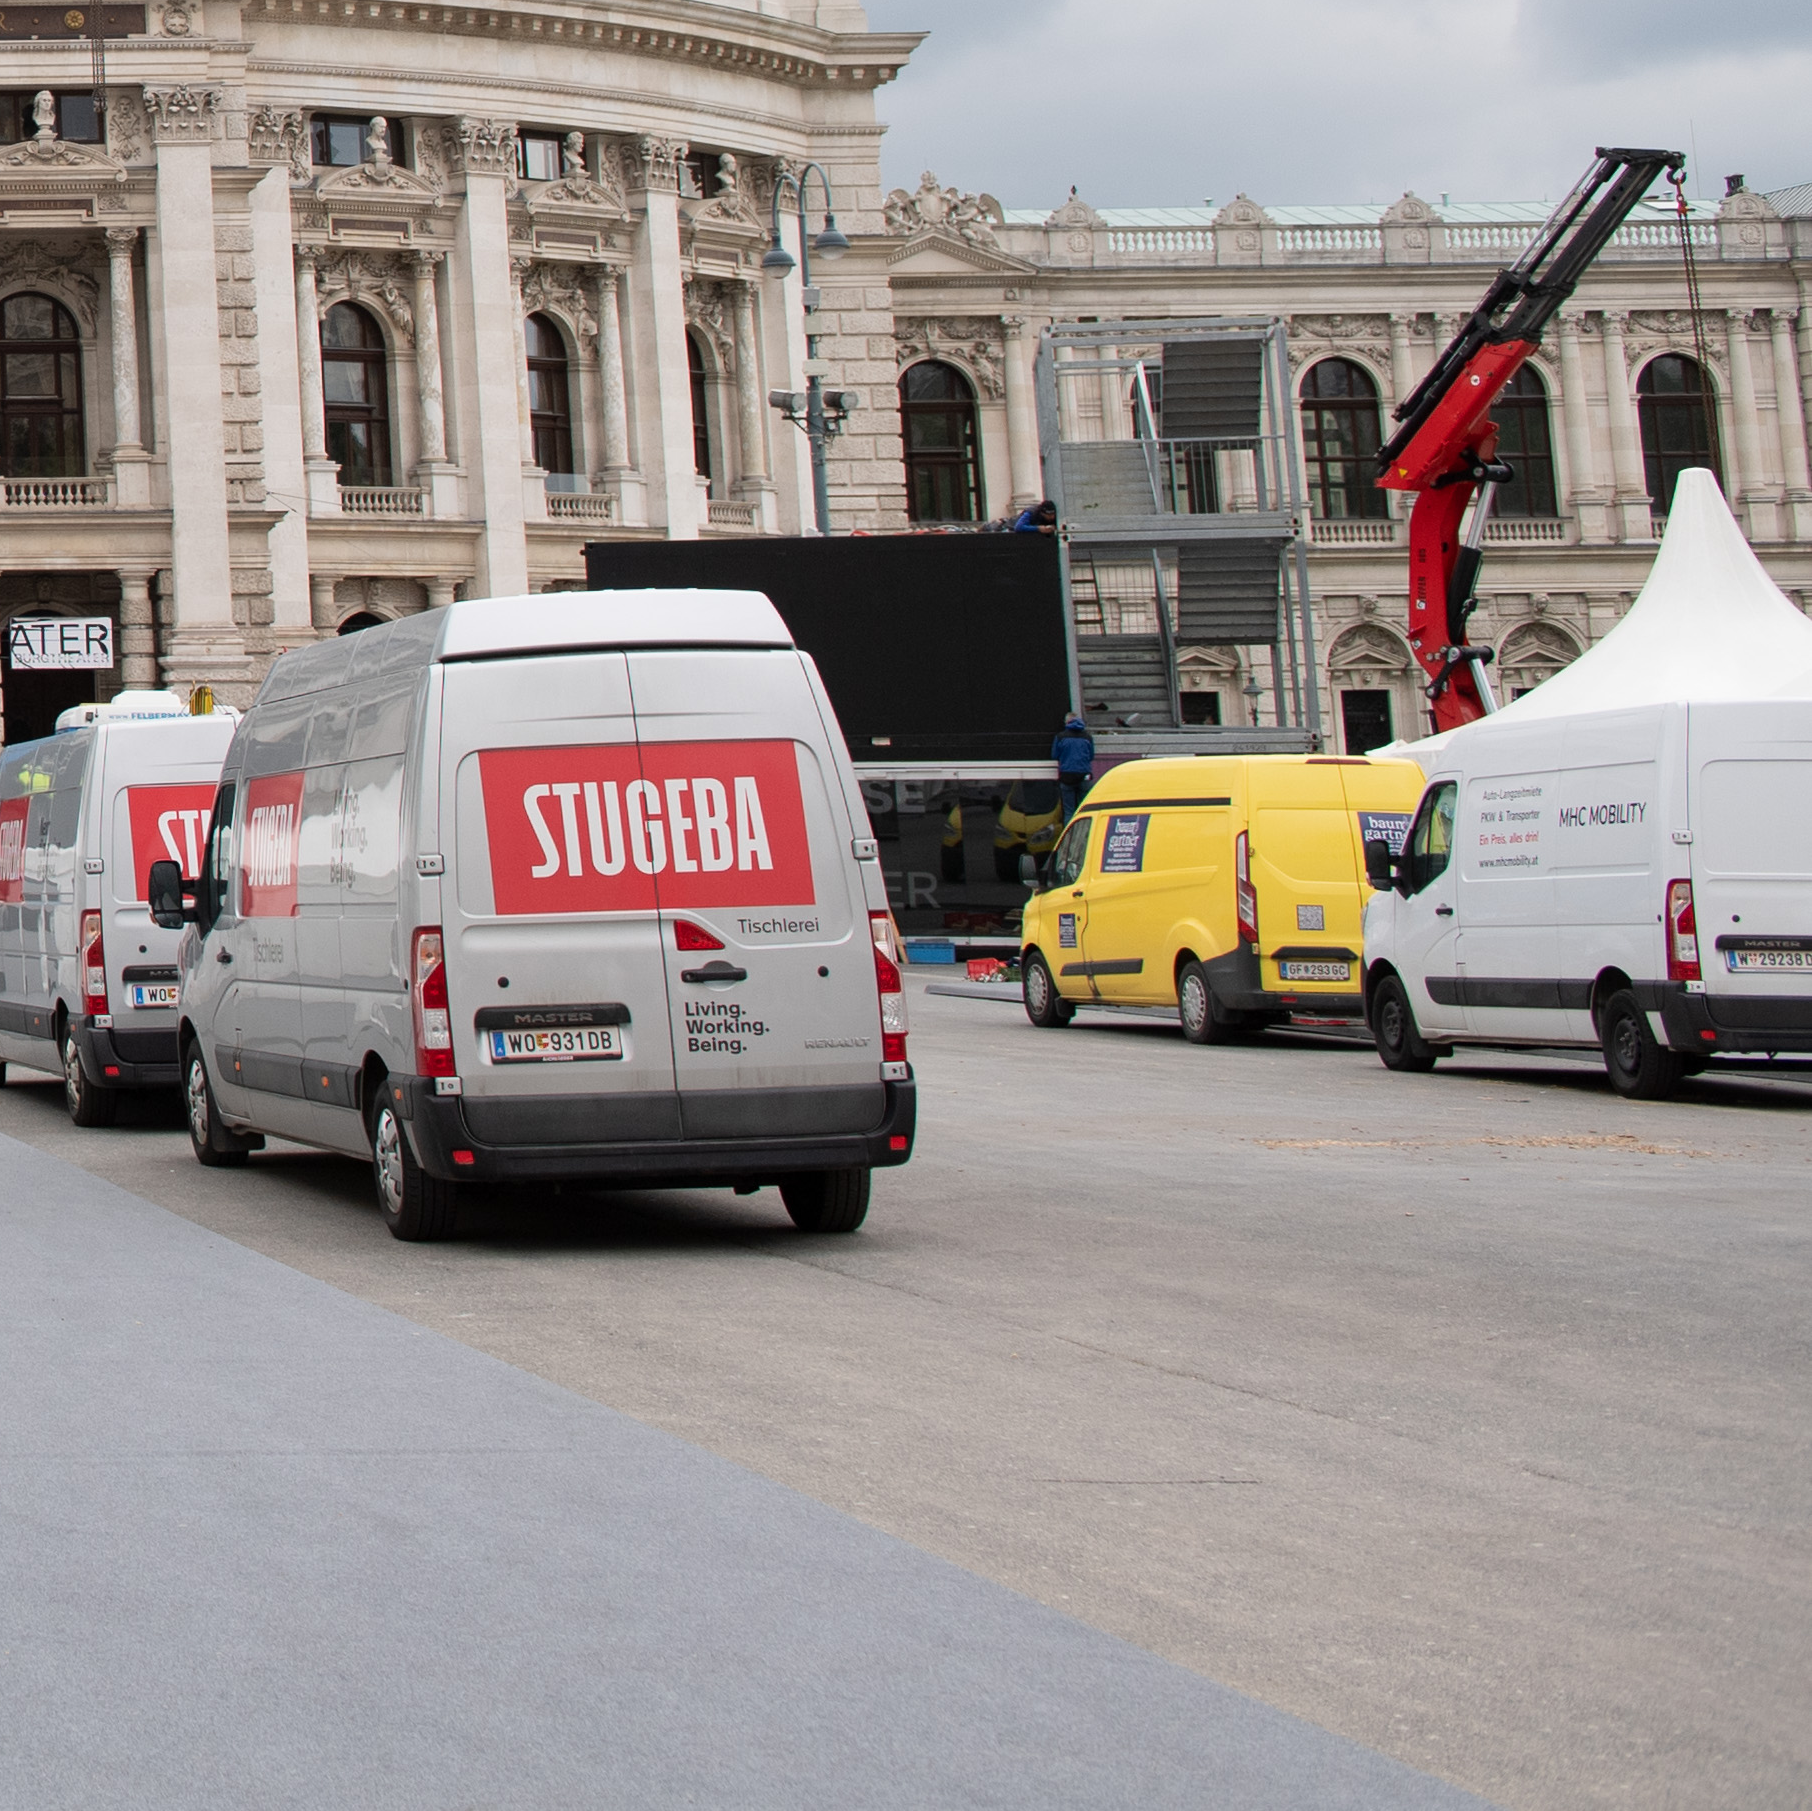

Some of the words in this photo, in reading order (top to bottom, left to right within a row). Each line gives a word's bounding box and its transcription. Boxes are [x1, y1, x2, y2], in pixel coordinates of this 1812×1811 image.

[11, 624, 109, 656] ATER
[1482, 786, 1543, 801] Auto-Langzeitmiete
[1480, 811, 1496, 823] PKW
[1498, 811, 1503, 822] &
[1506, 809, 1540, 823] Transporter
[1559, 806, 1587, 827] MHC
[1589, 802, 1647, 826] MOBILITY
[523, 776, 774, 878] STUGEBA
[1479, 835, 1489, 845] Ein
[1509, 832, 1523, 844] alles
[1525, 831, 1539, 843] drin!
[1478, 855, 1539, 868] www.mhcmobility.at
[737, 918, 820, 934] Tischlerei
[1737, 952, 1748, 965] W
[1289, 964, 1302, 974] GF
[685, 1001, 747, 1018] Living.
[514, 1012, 594, 1023] MASTER
[685, 1019, 770, 1035] Working.
[508, 1033, 536, 1053] WO
[688, 1038, 748, 1054] Being.
[805, 1037, 870, 1049] RENAULT
